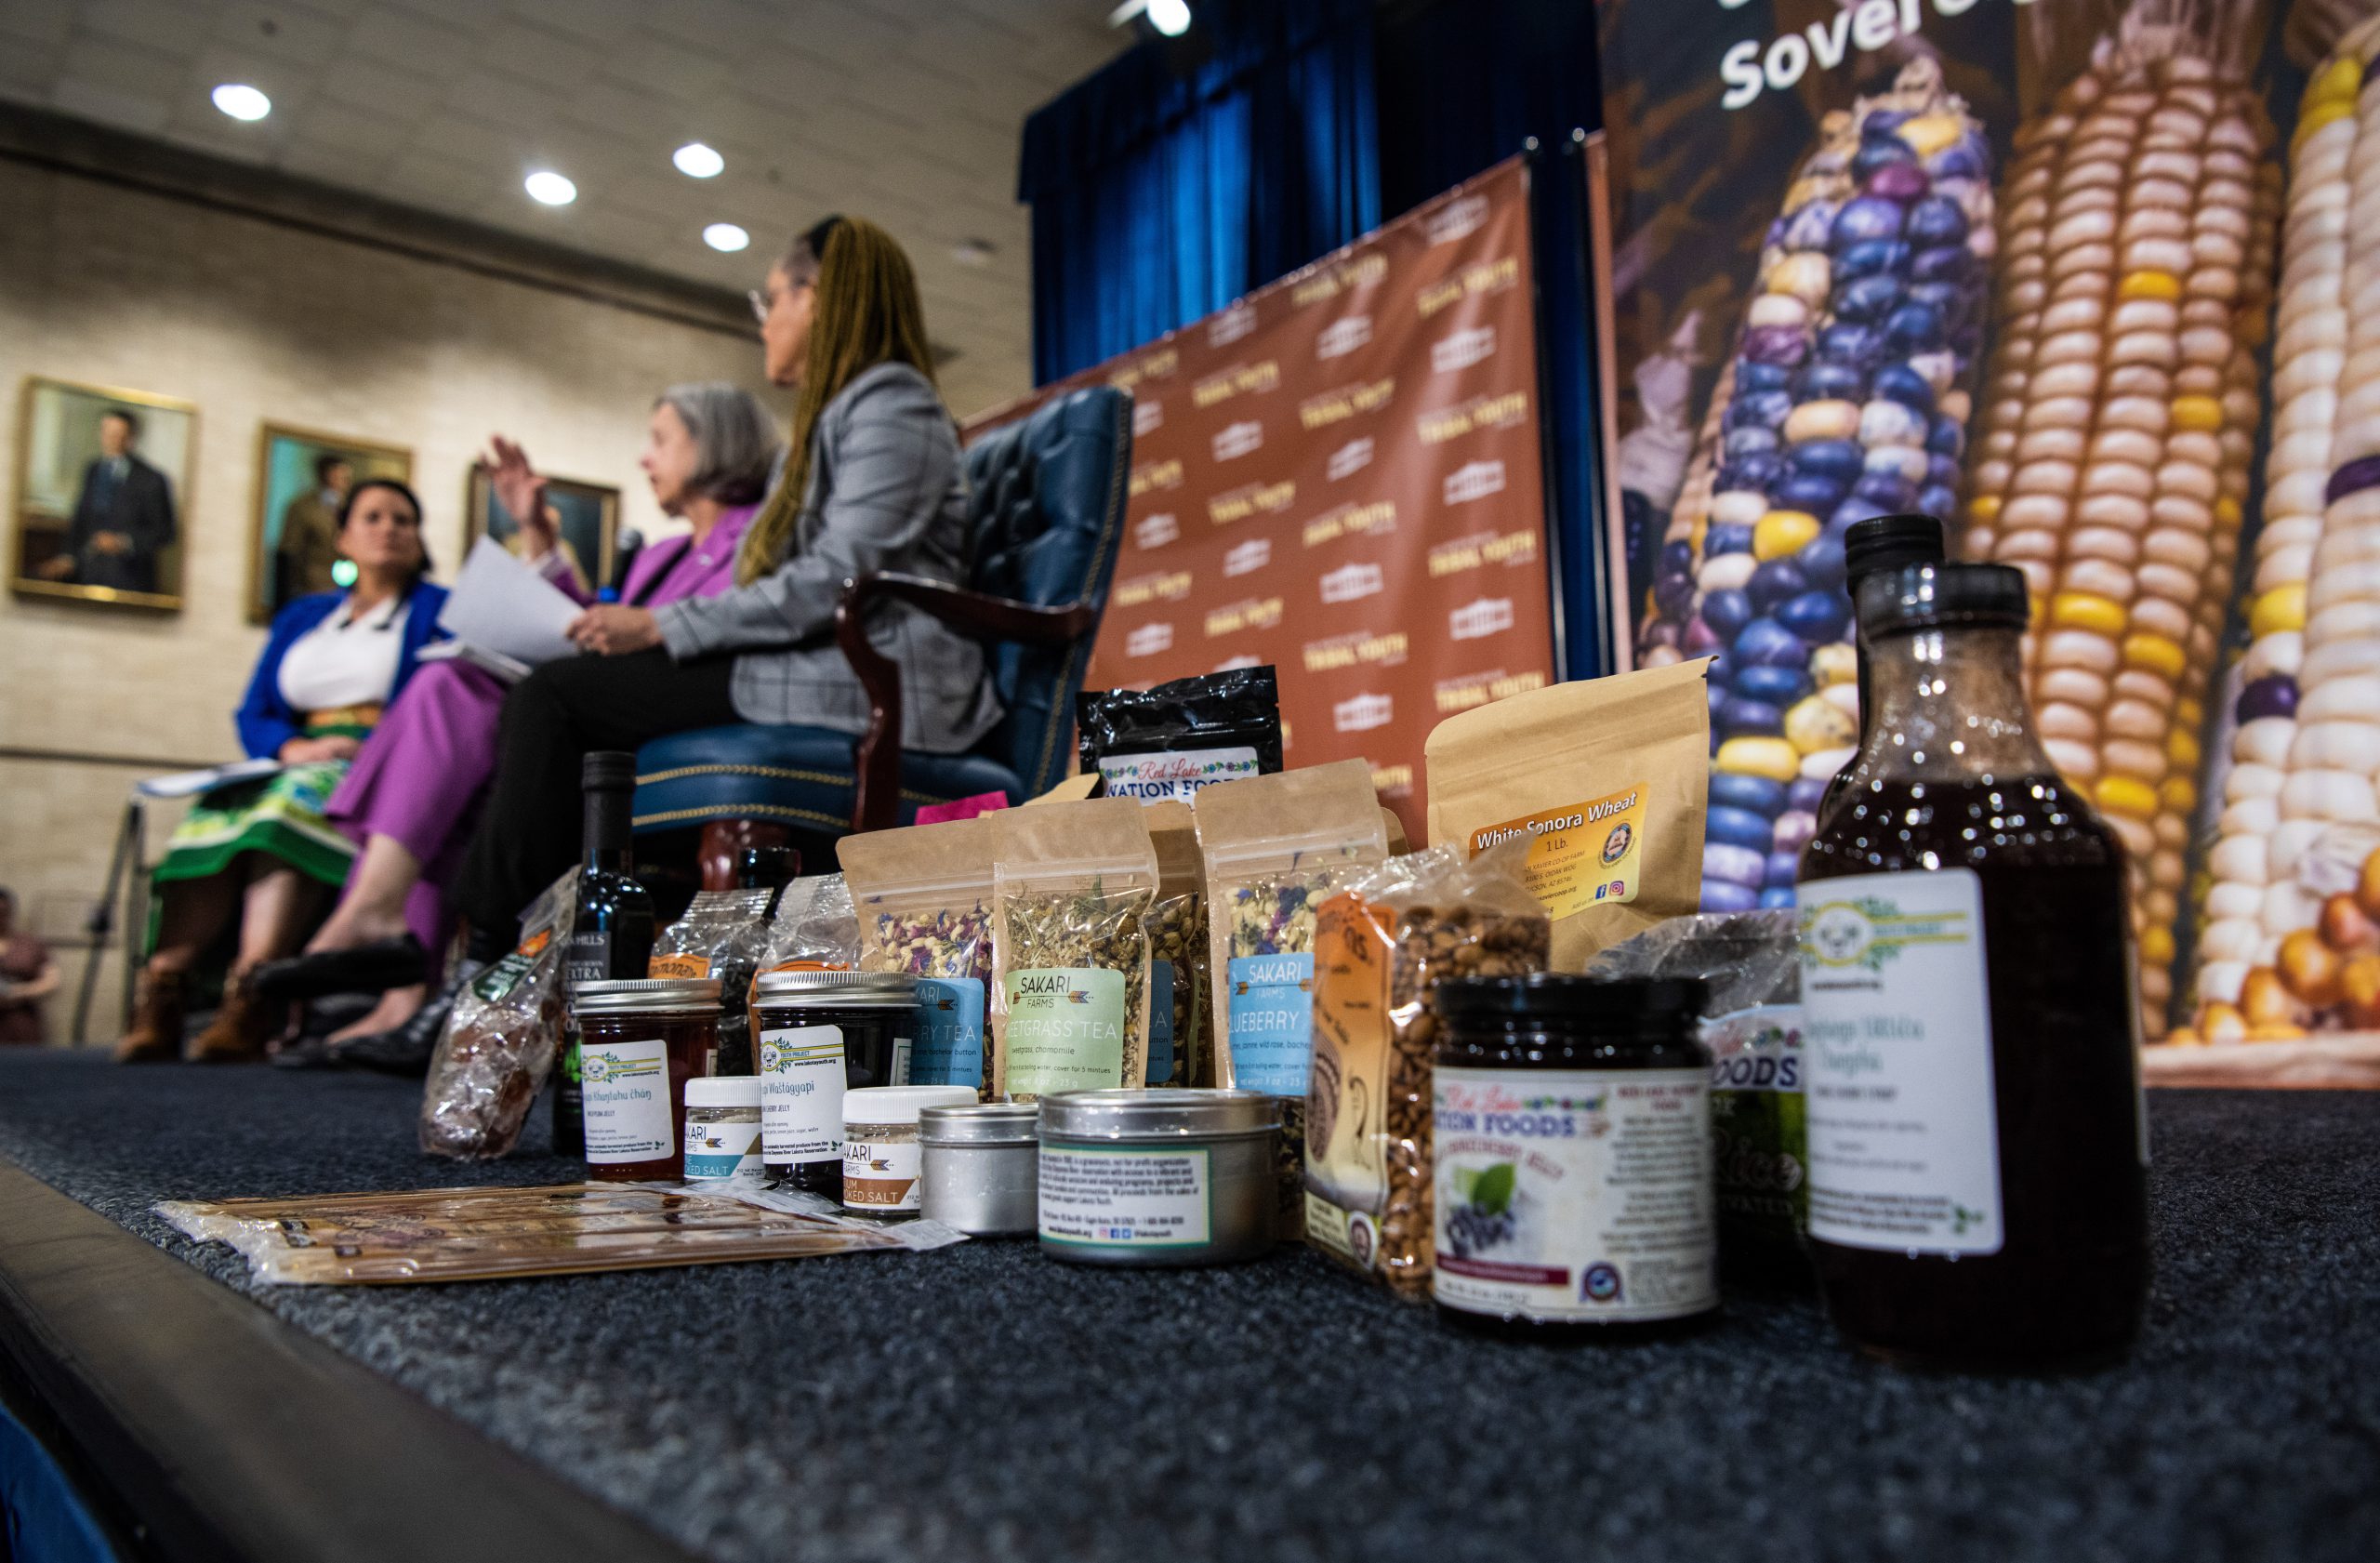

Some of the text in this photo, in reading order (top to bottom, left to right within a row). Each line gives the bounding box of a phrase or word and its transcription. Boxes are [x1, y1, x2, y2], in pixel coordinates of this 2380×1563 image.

[1138, 758, 1201, 780] Red Lake
[1106, 779, 1175, 798] NATION
[1477, 791, 1637, 850] White Sonora Wheat
[1547, 838, 1568, 852] 1 Lb.
[1250, 961, 1302, 984] SAKARI
[1021, 975, 1071, 994] SAKARI
[1257, 987, 1286, 1000] FARMS
[1026, 998, 1054, 1009] FARMS
[1080, 1021, 1117, 1040] TEA
[1229, 1011, 1300, 1033] LUEBERRY
[944, 1026, 976, 1041] TEA
[1035, 1046, 1075, 1054] chamomile
[1485, 1113, 1575, 1137] FOODS
[703, 1166, 729, 1175] SALT
[868, 1192, 898, 1203] SALT
